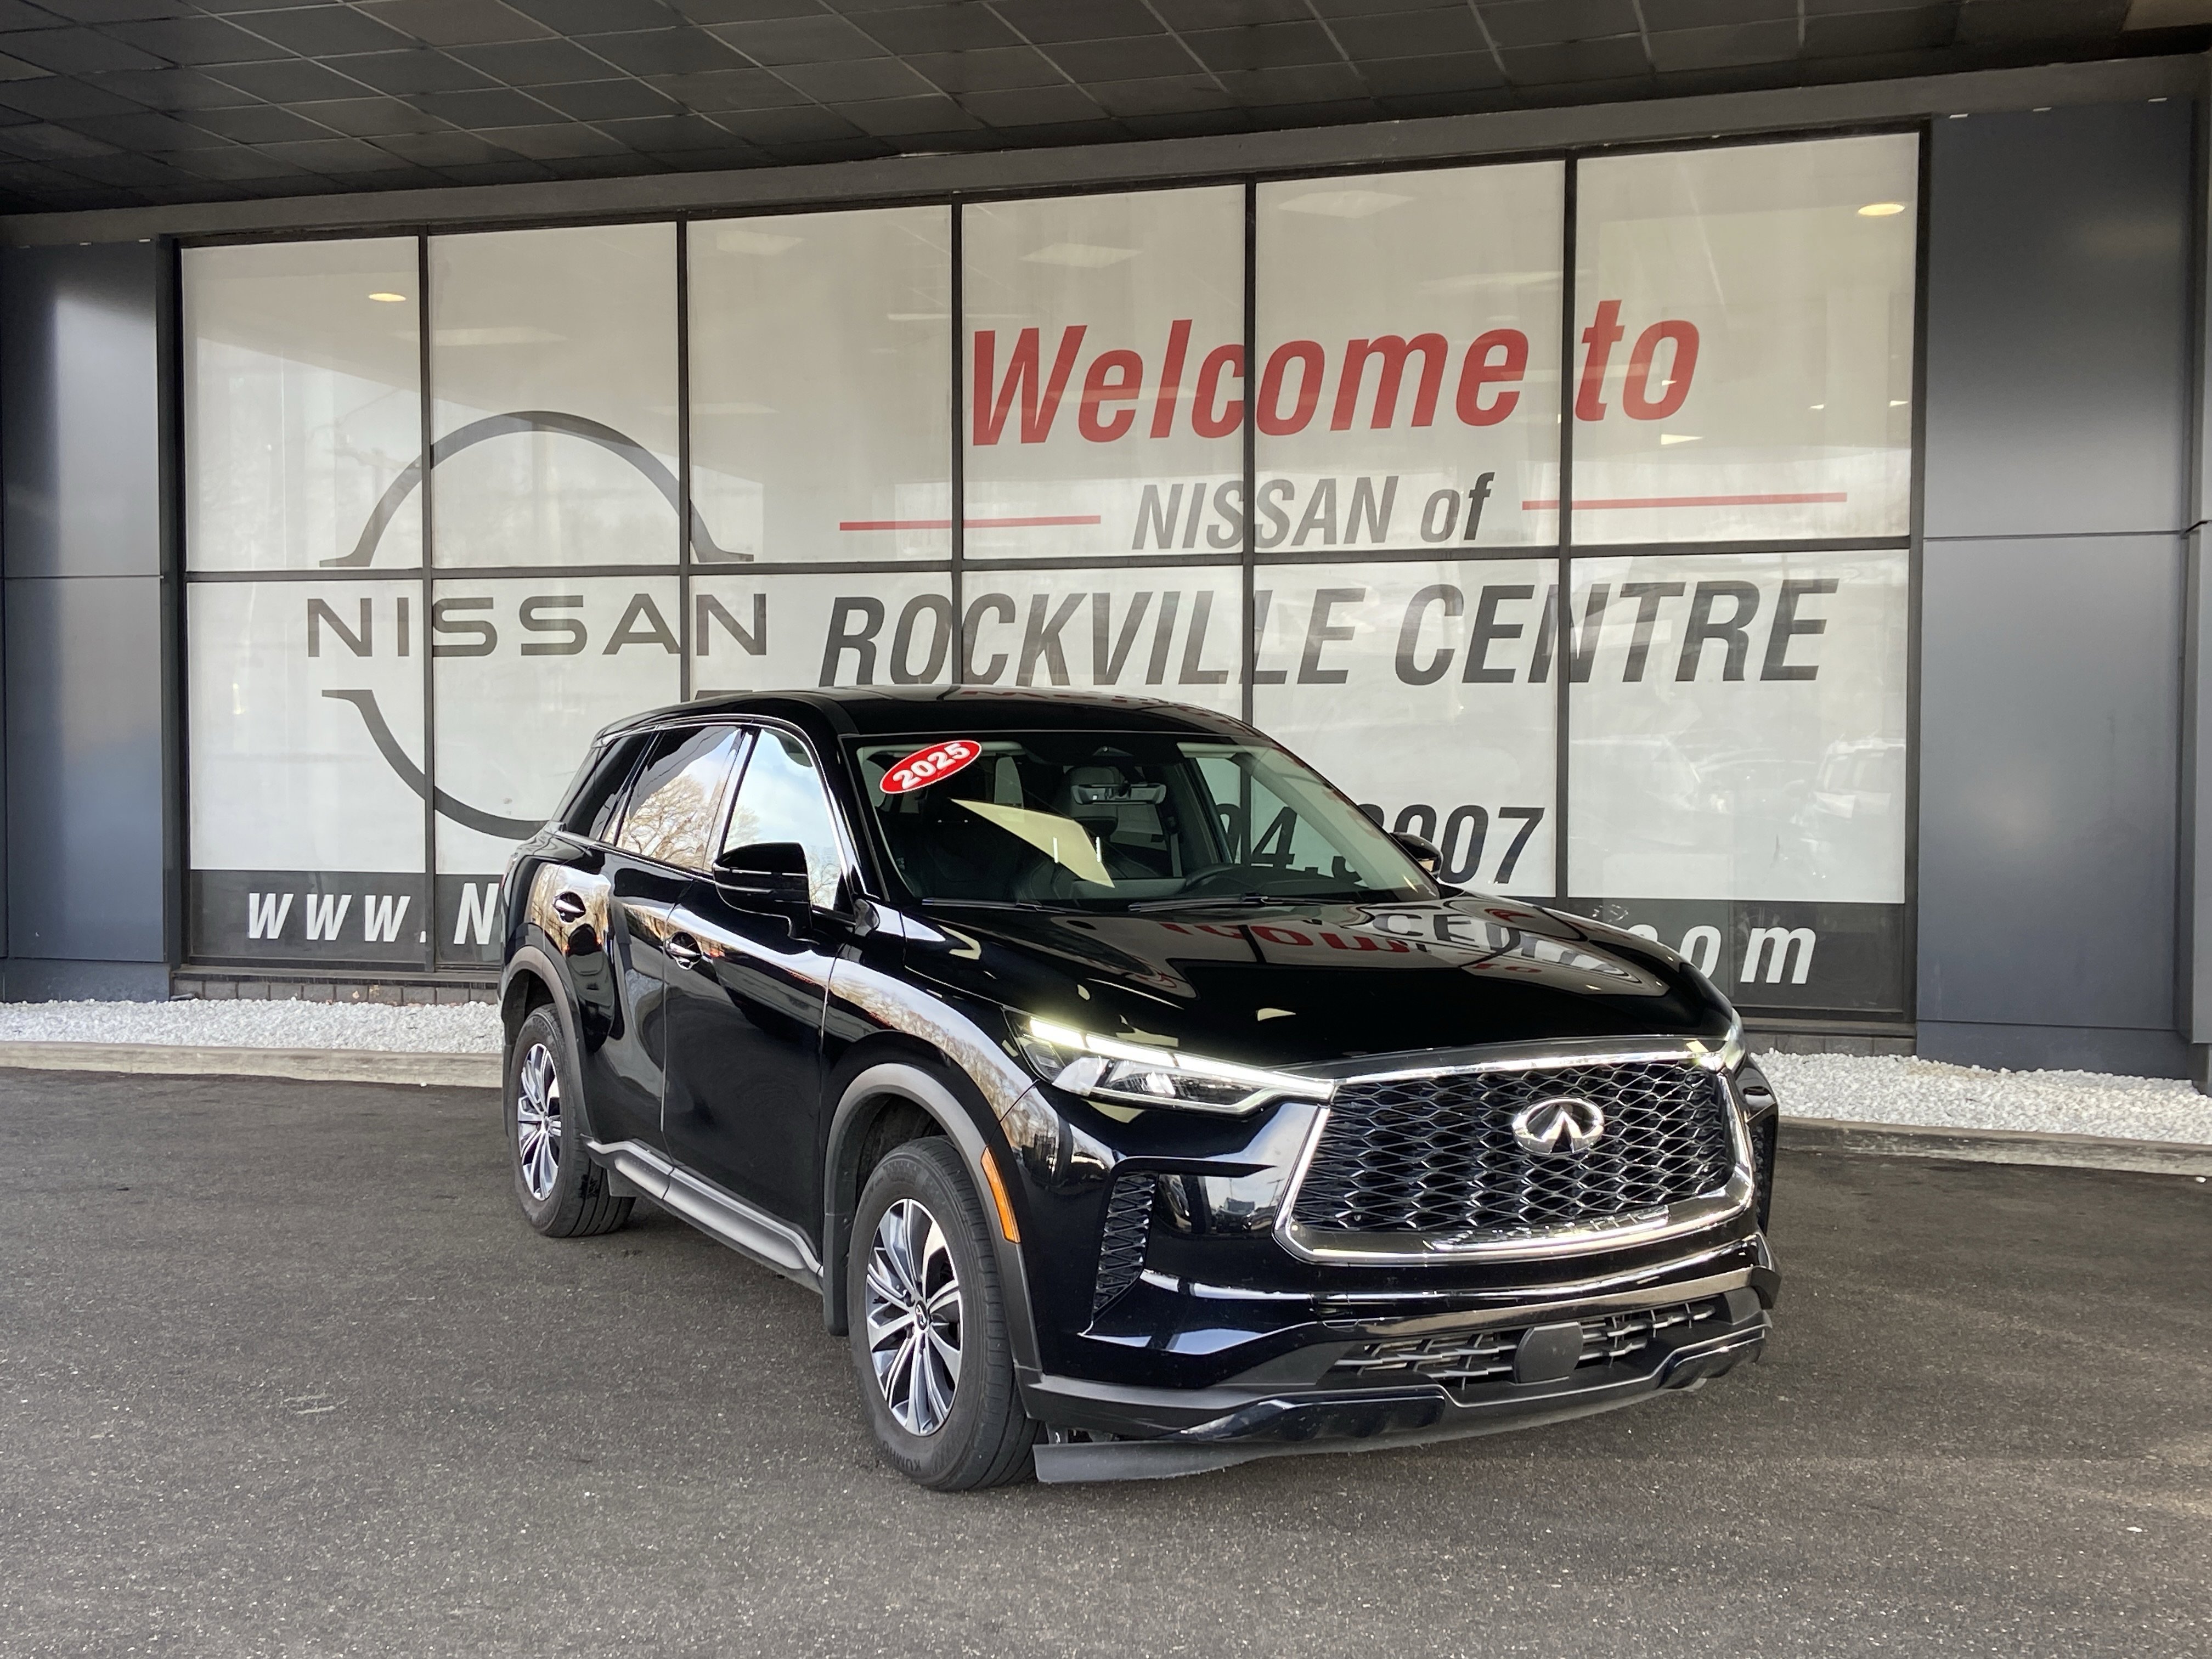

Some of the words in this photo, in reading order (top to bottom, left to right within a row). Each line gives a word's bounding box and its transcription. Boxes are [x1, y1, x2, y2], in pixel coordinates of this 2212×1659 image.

[973, 319, 1529, 446] Welcome
[1575, 300, 1700, 422] to
[1132, 476, 1398, 550] NISSAN
[1420, 472, 1496, 543] of
[307, 593, 766, 658] NISSAN
[818, 587, 1366, 687] ROCKVILLE
[1394, 578, 1839, 686] CENTRE
[893, 743, 970, 789] 2025
[882, 1440, 922, 1472] KUMHO
